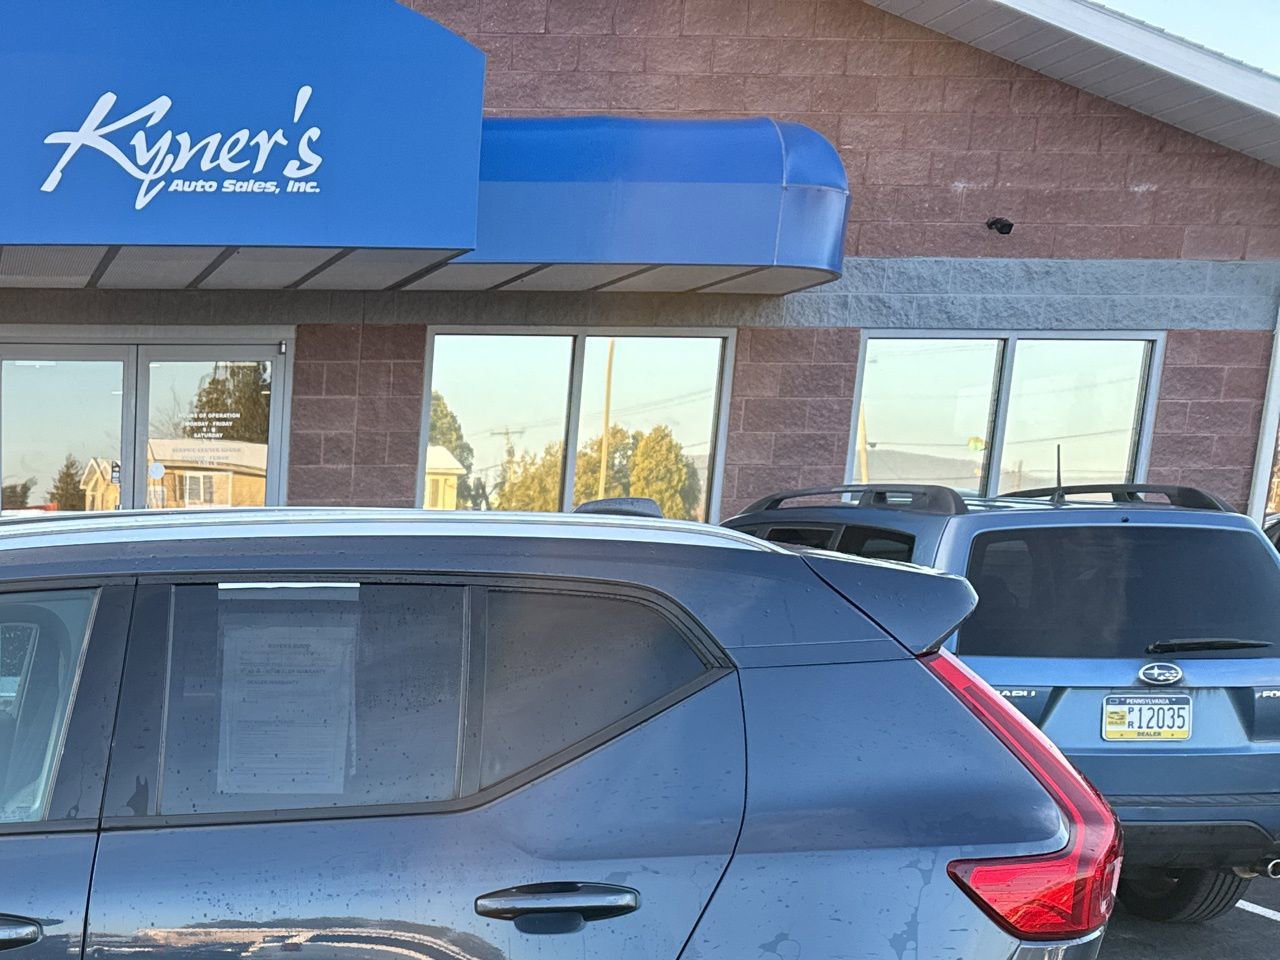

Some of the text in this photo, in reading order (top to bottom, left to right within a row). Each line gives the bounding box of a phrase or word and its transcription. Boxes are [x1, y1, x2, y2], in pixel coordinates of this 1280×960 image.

[40, 85, 323, 210] Kyner's
[168, 179, 320, 194] Auto Sales, Inc.
[1137, 707, 1186, 729] 12035
